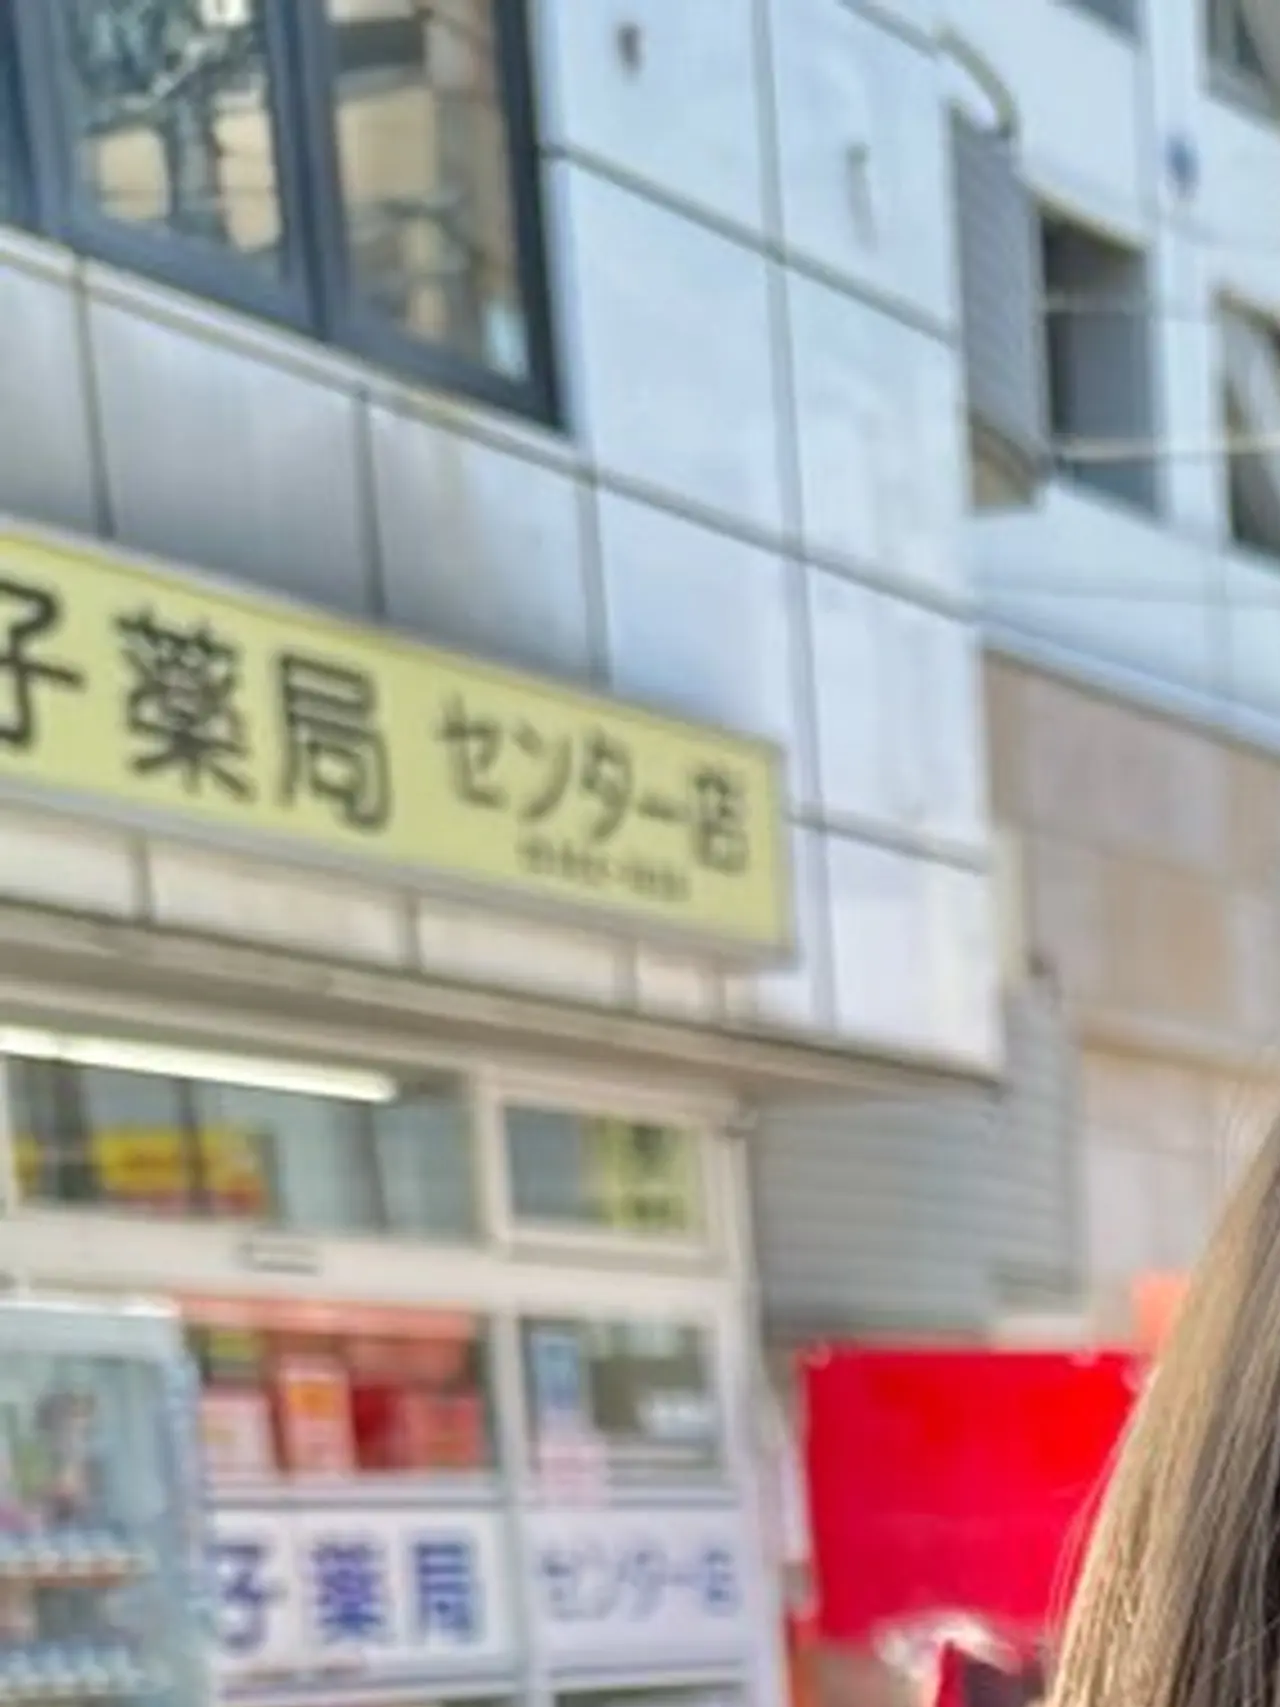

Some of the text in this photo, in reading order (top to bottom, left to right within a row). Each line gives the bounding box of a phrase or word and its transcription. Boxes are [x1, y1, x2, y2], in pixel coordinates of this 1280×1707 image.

[432, 692, 750, 876] センター店
